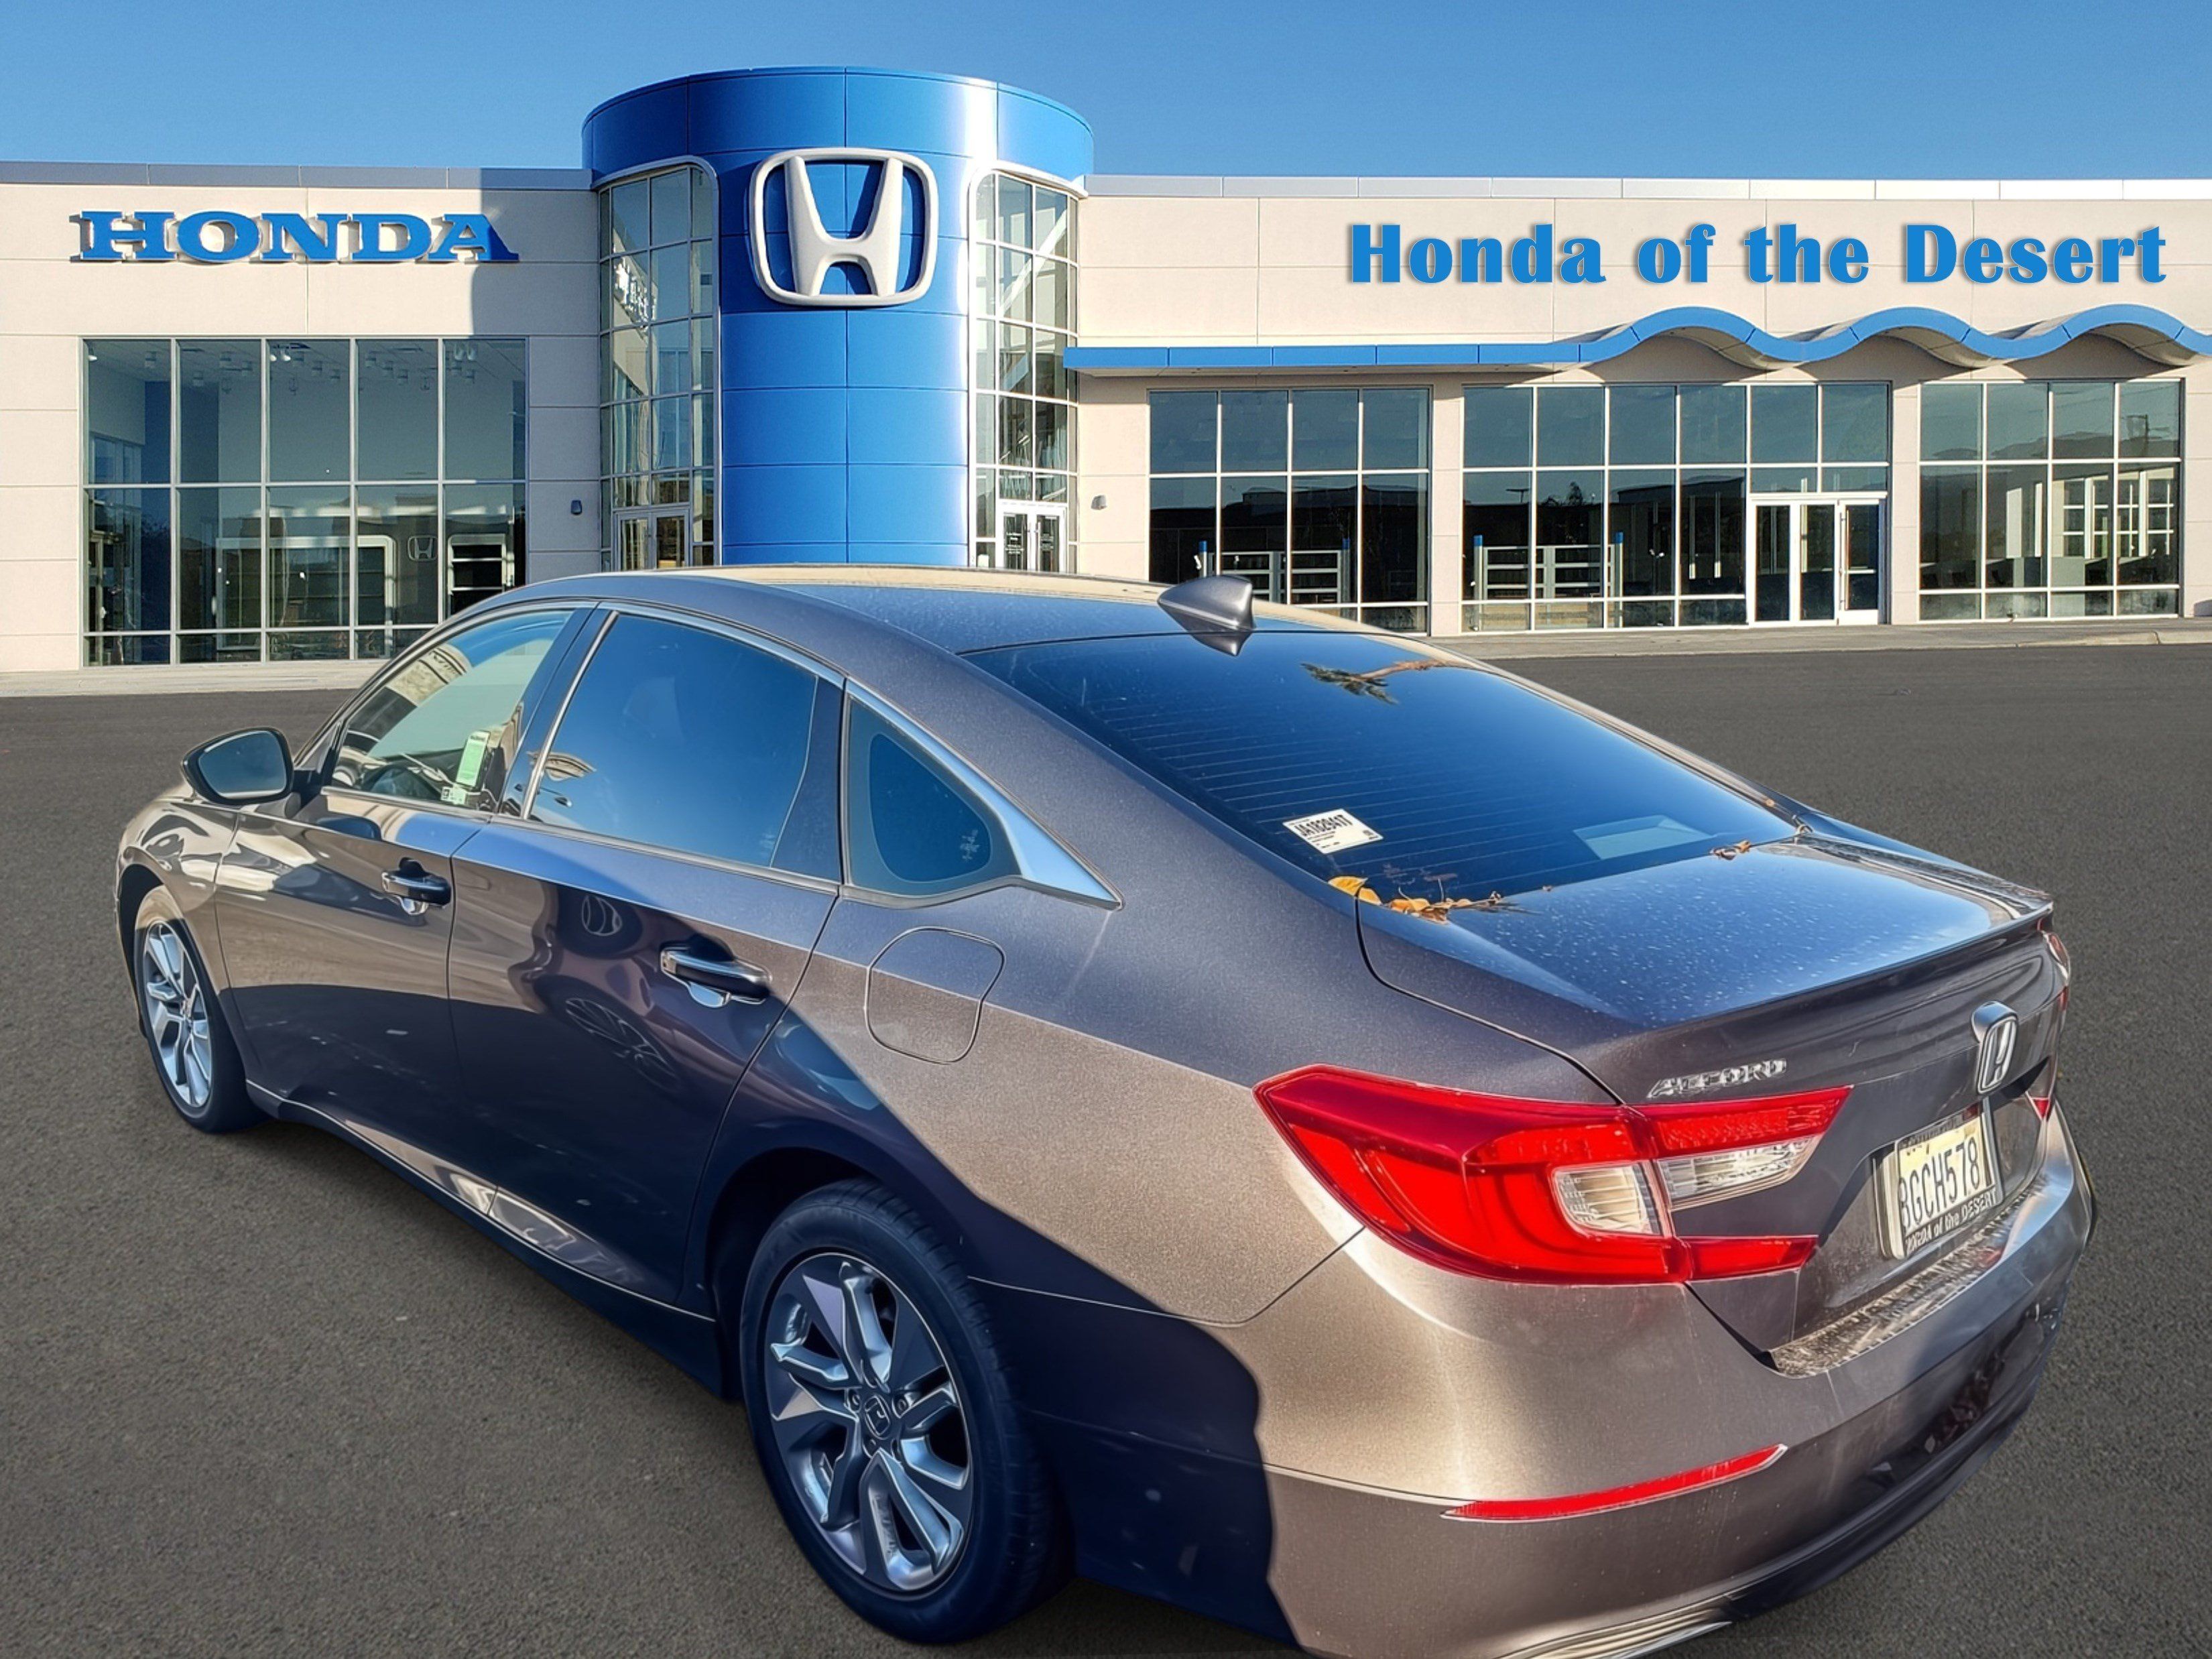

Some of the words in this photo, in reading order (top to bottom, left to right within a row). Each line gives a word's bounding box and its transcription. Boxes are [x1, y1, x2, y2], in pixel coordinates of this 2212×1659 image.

[76, 210, 519, 263] HONDA
[1350, 223, 1606, 284] Honda
[1636, 223, 1716, 284] of
[1744, 223, 1869, 284] the
[1904, 223, 2166, 284] Desert
[1934, 1221, 1944, 1237] of
[1945, 1211, 1960, 1231] the
[1961, 1188, 1997, 1221] DESERT
